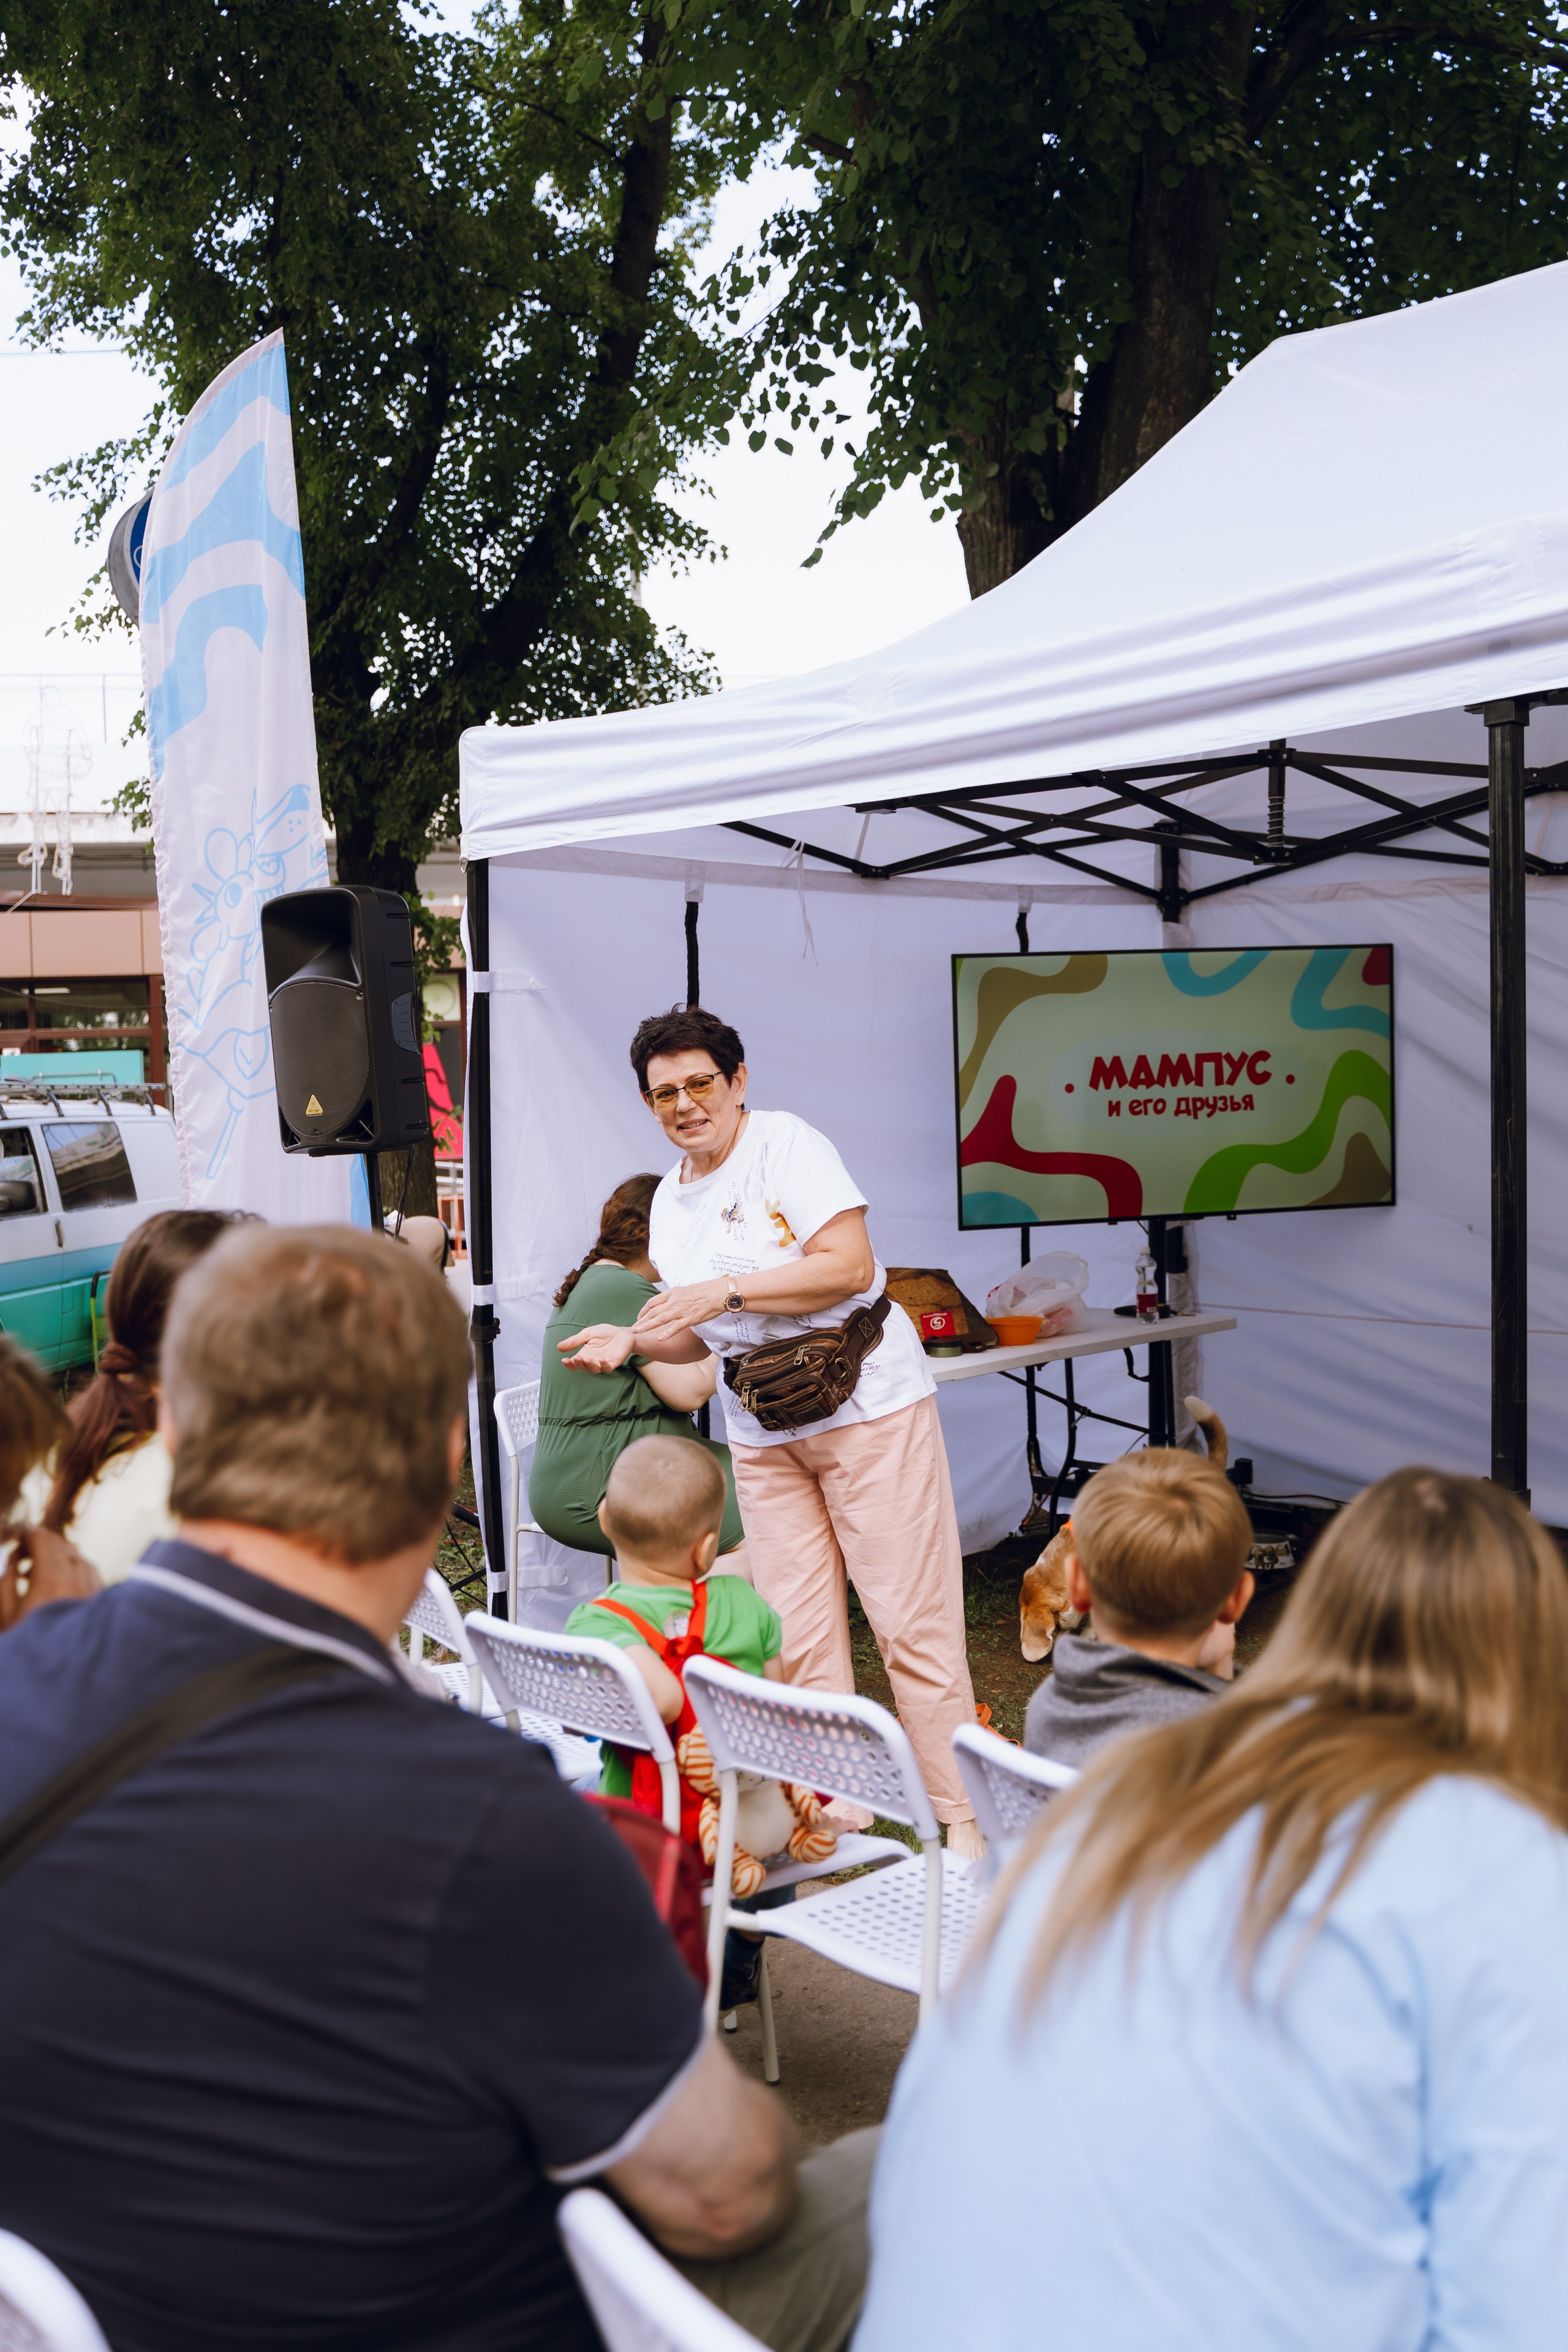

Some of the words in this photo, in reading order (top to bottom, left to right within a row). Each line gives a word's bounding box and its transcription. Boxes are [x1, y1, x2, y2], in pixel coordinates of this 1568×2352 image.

[1089, 1050, 1272, 1091] МАМПУС
[1107, 1100, 1121, 1117] и
[1128, 1098, 1167, 1116] его
[1174, 1094, 1255, 1120] друзья
